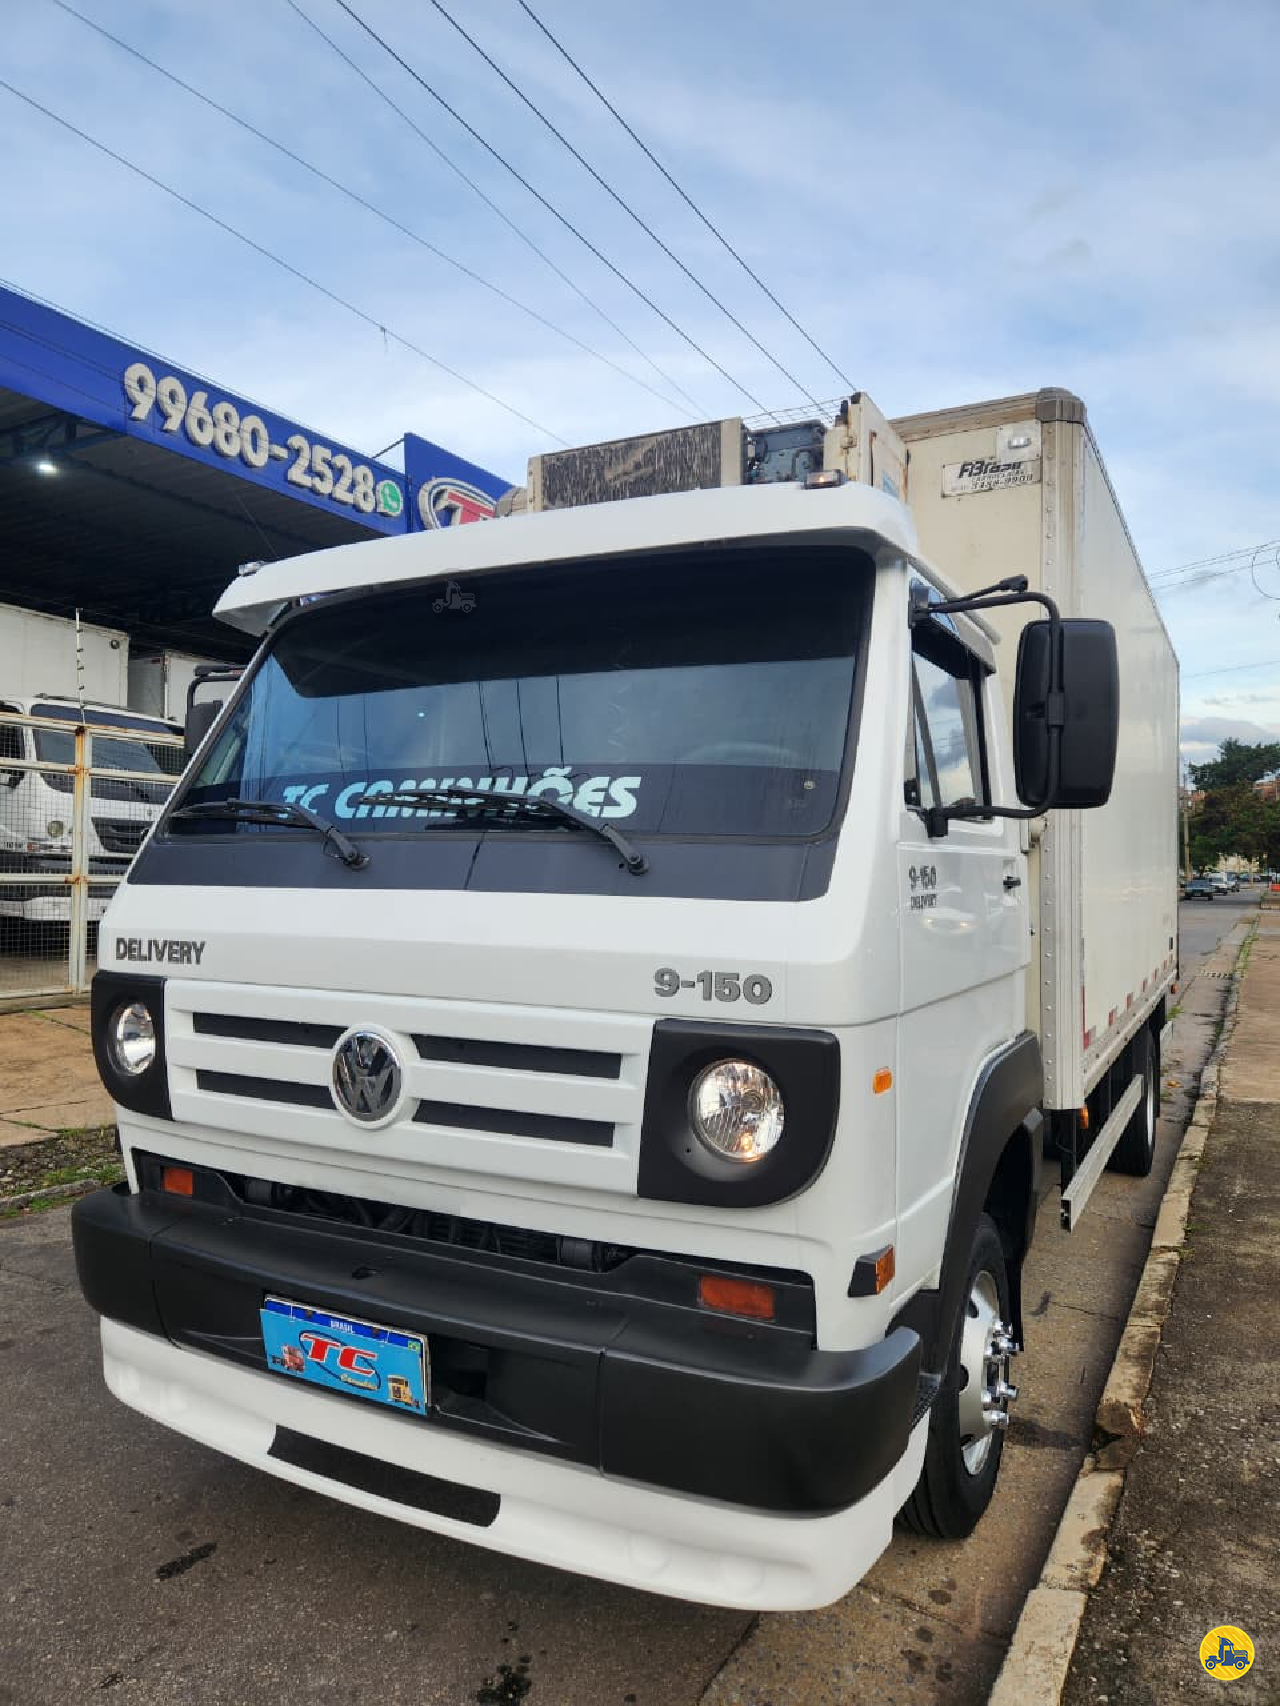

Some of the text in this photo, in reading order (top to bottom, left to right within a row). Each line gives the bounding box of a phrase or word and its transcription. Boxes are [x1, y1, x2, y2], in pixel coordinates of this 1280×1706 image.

[124, 362, 375, 513] 99680-2528
[909, 865, 937, 890] 9-150
[116, 937, 206, 965] DELIVERY
[654, 967, 773, 1005] 9-150
[300, 1333, 377, 1376] TC
